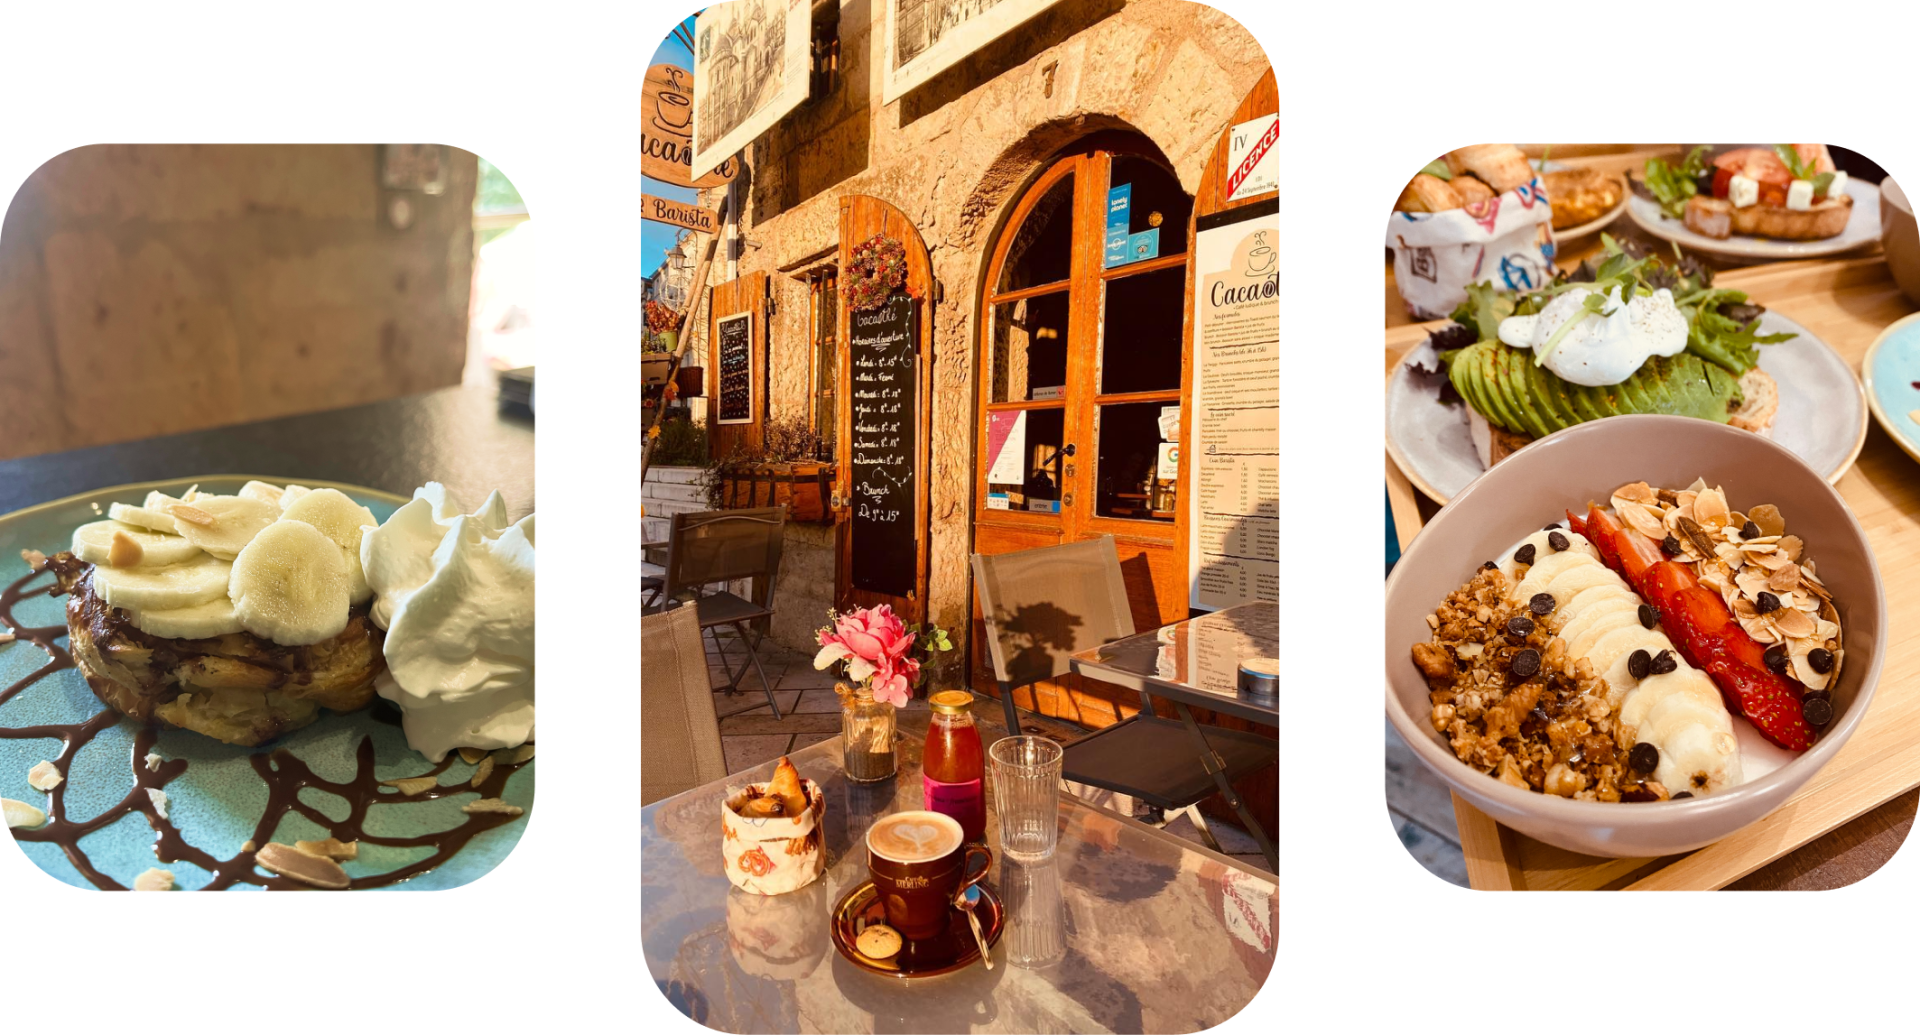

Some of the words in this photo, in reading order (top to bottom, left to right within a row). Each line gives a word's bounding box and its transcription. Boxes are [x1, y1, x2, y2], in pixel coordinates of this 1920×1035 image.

[1233, 133, 1248, 152] IV
[1232, 124, 1278, 191] LICENCE
[653, 198, 711, 229] Barista
[861, 481, 890, 496] Brunch
[858, 503, 870, 519] De
[895, 879, 930, 889] MERLING
